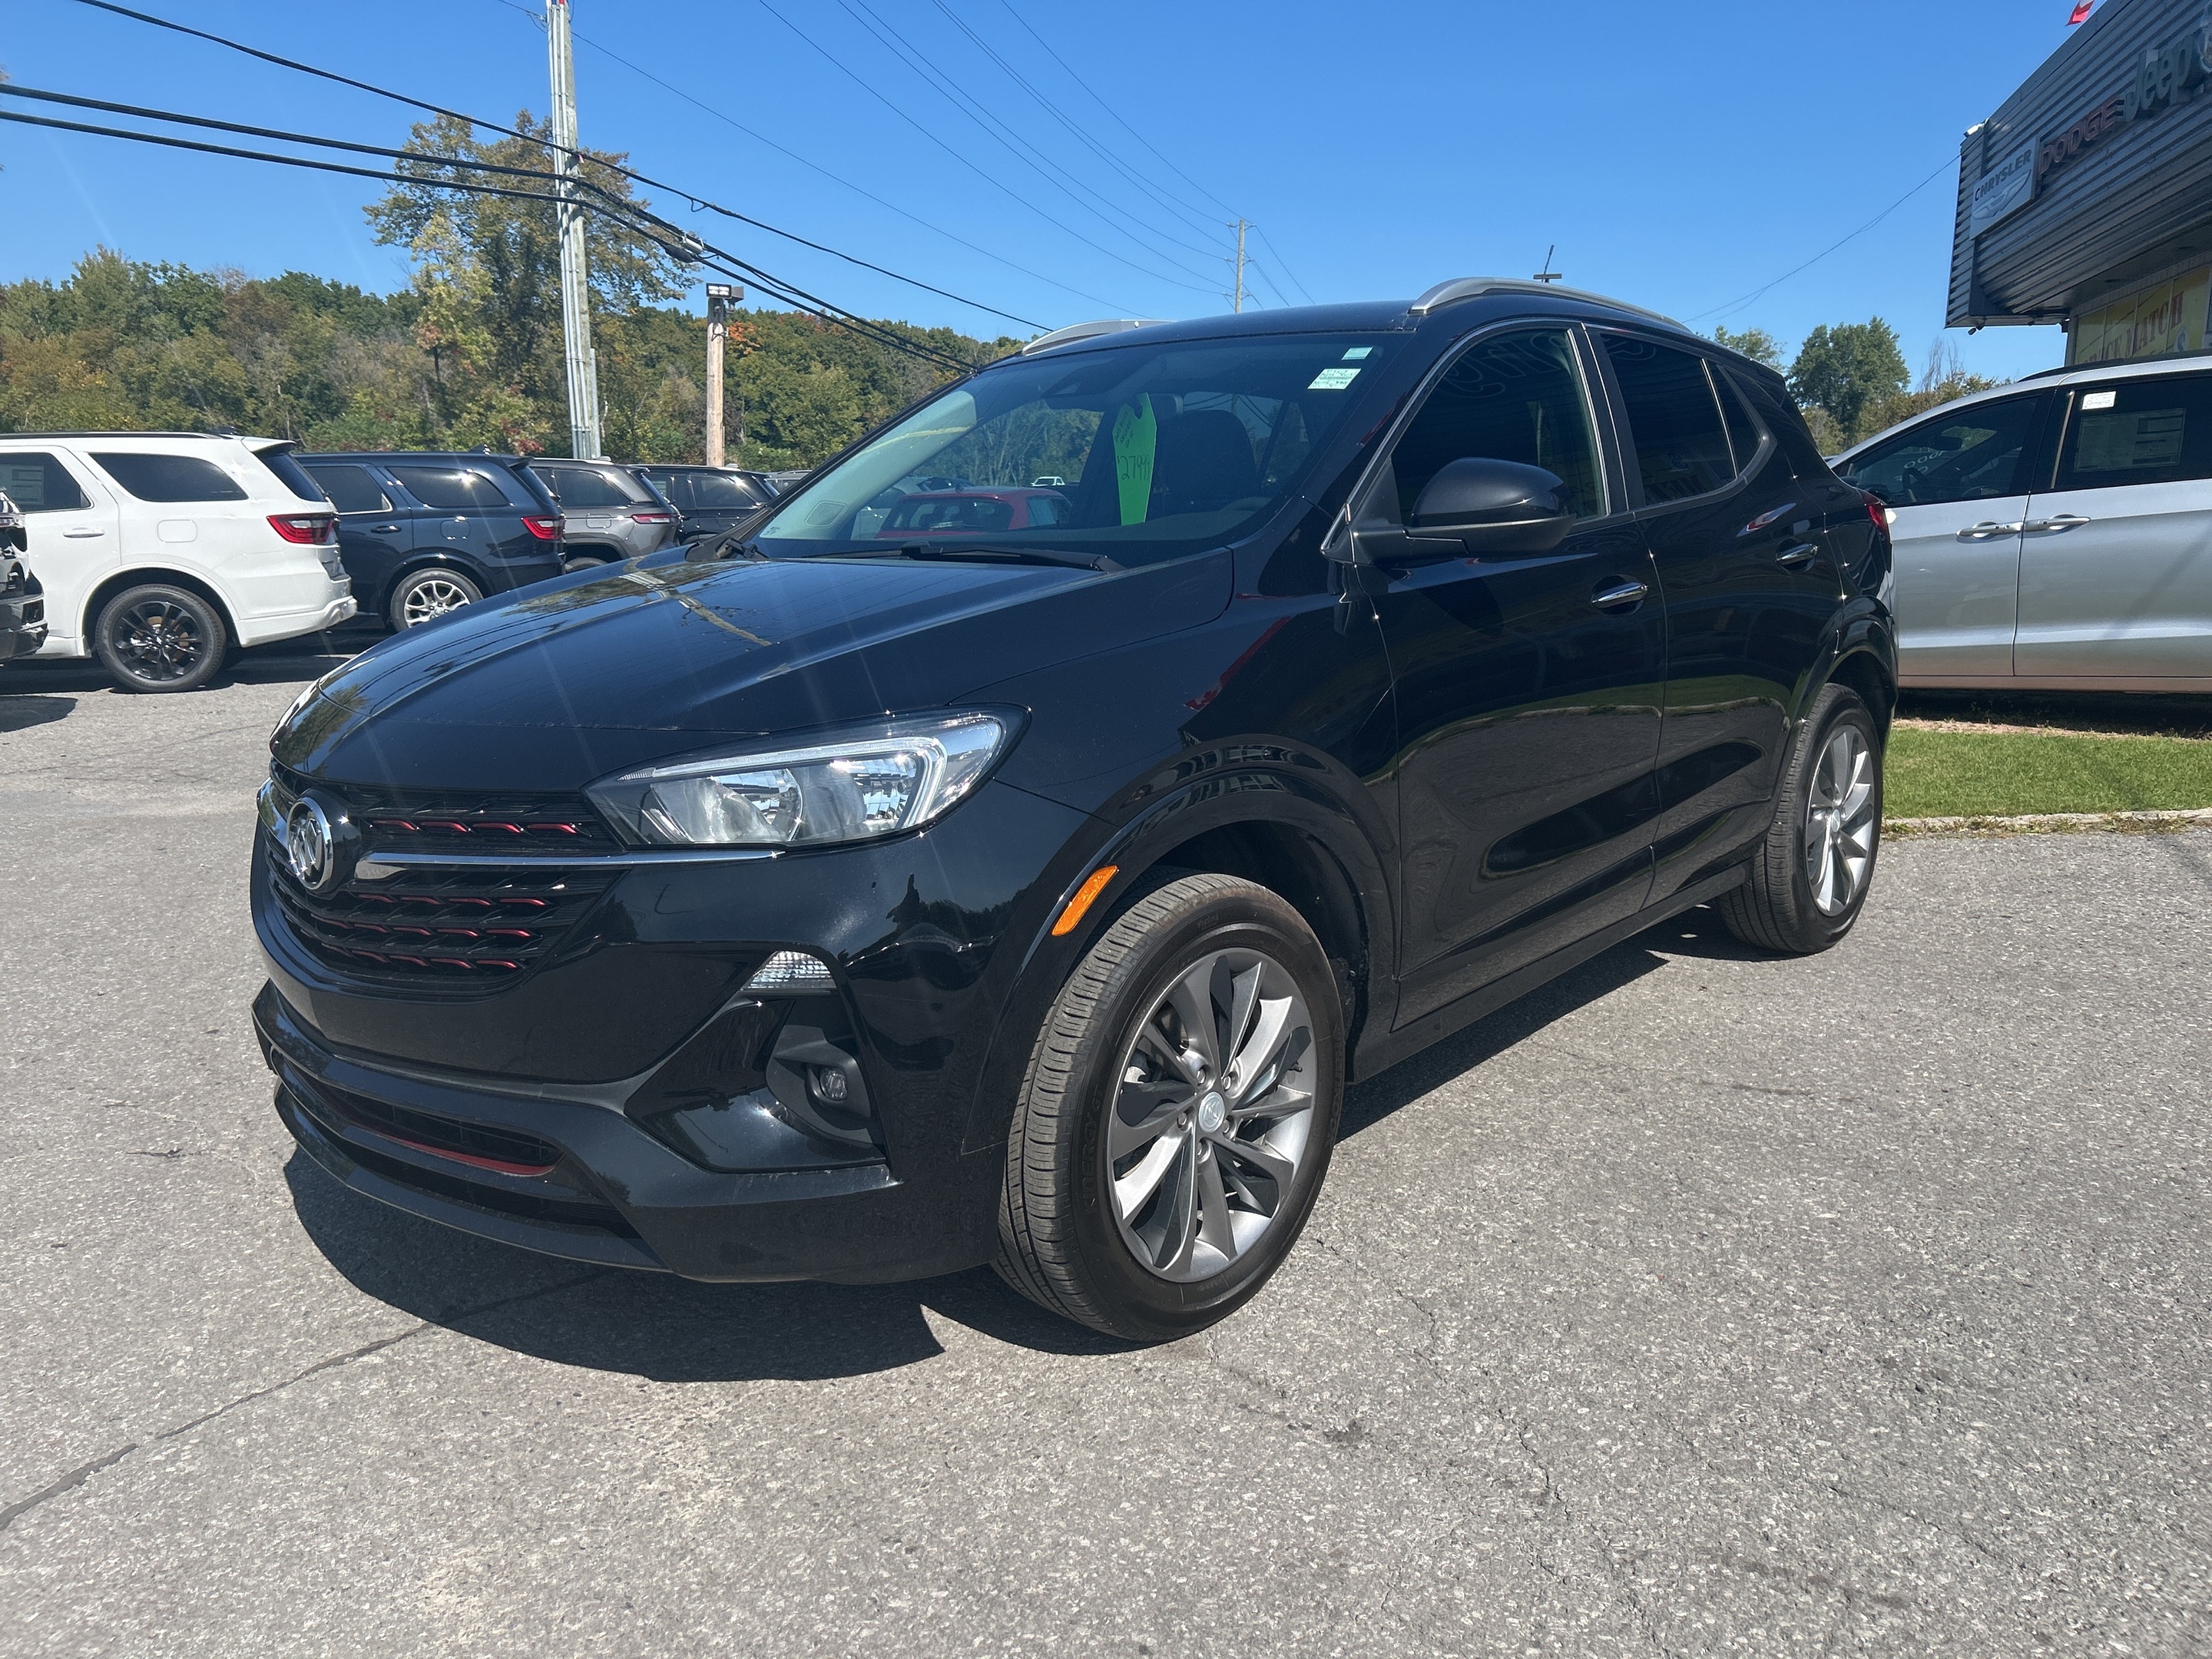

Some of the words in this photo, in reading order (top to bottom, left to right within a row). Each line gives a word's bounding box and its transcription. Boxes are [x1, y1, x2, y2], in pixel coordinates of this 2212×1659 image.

[2124, 35, 2194, 121] Jeep
[1975, 149, 2032, 201] CHRYSLER
[2038, 94, 2125, 175] DODGE
